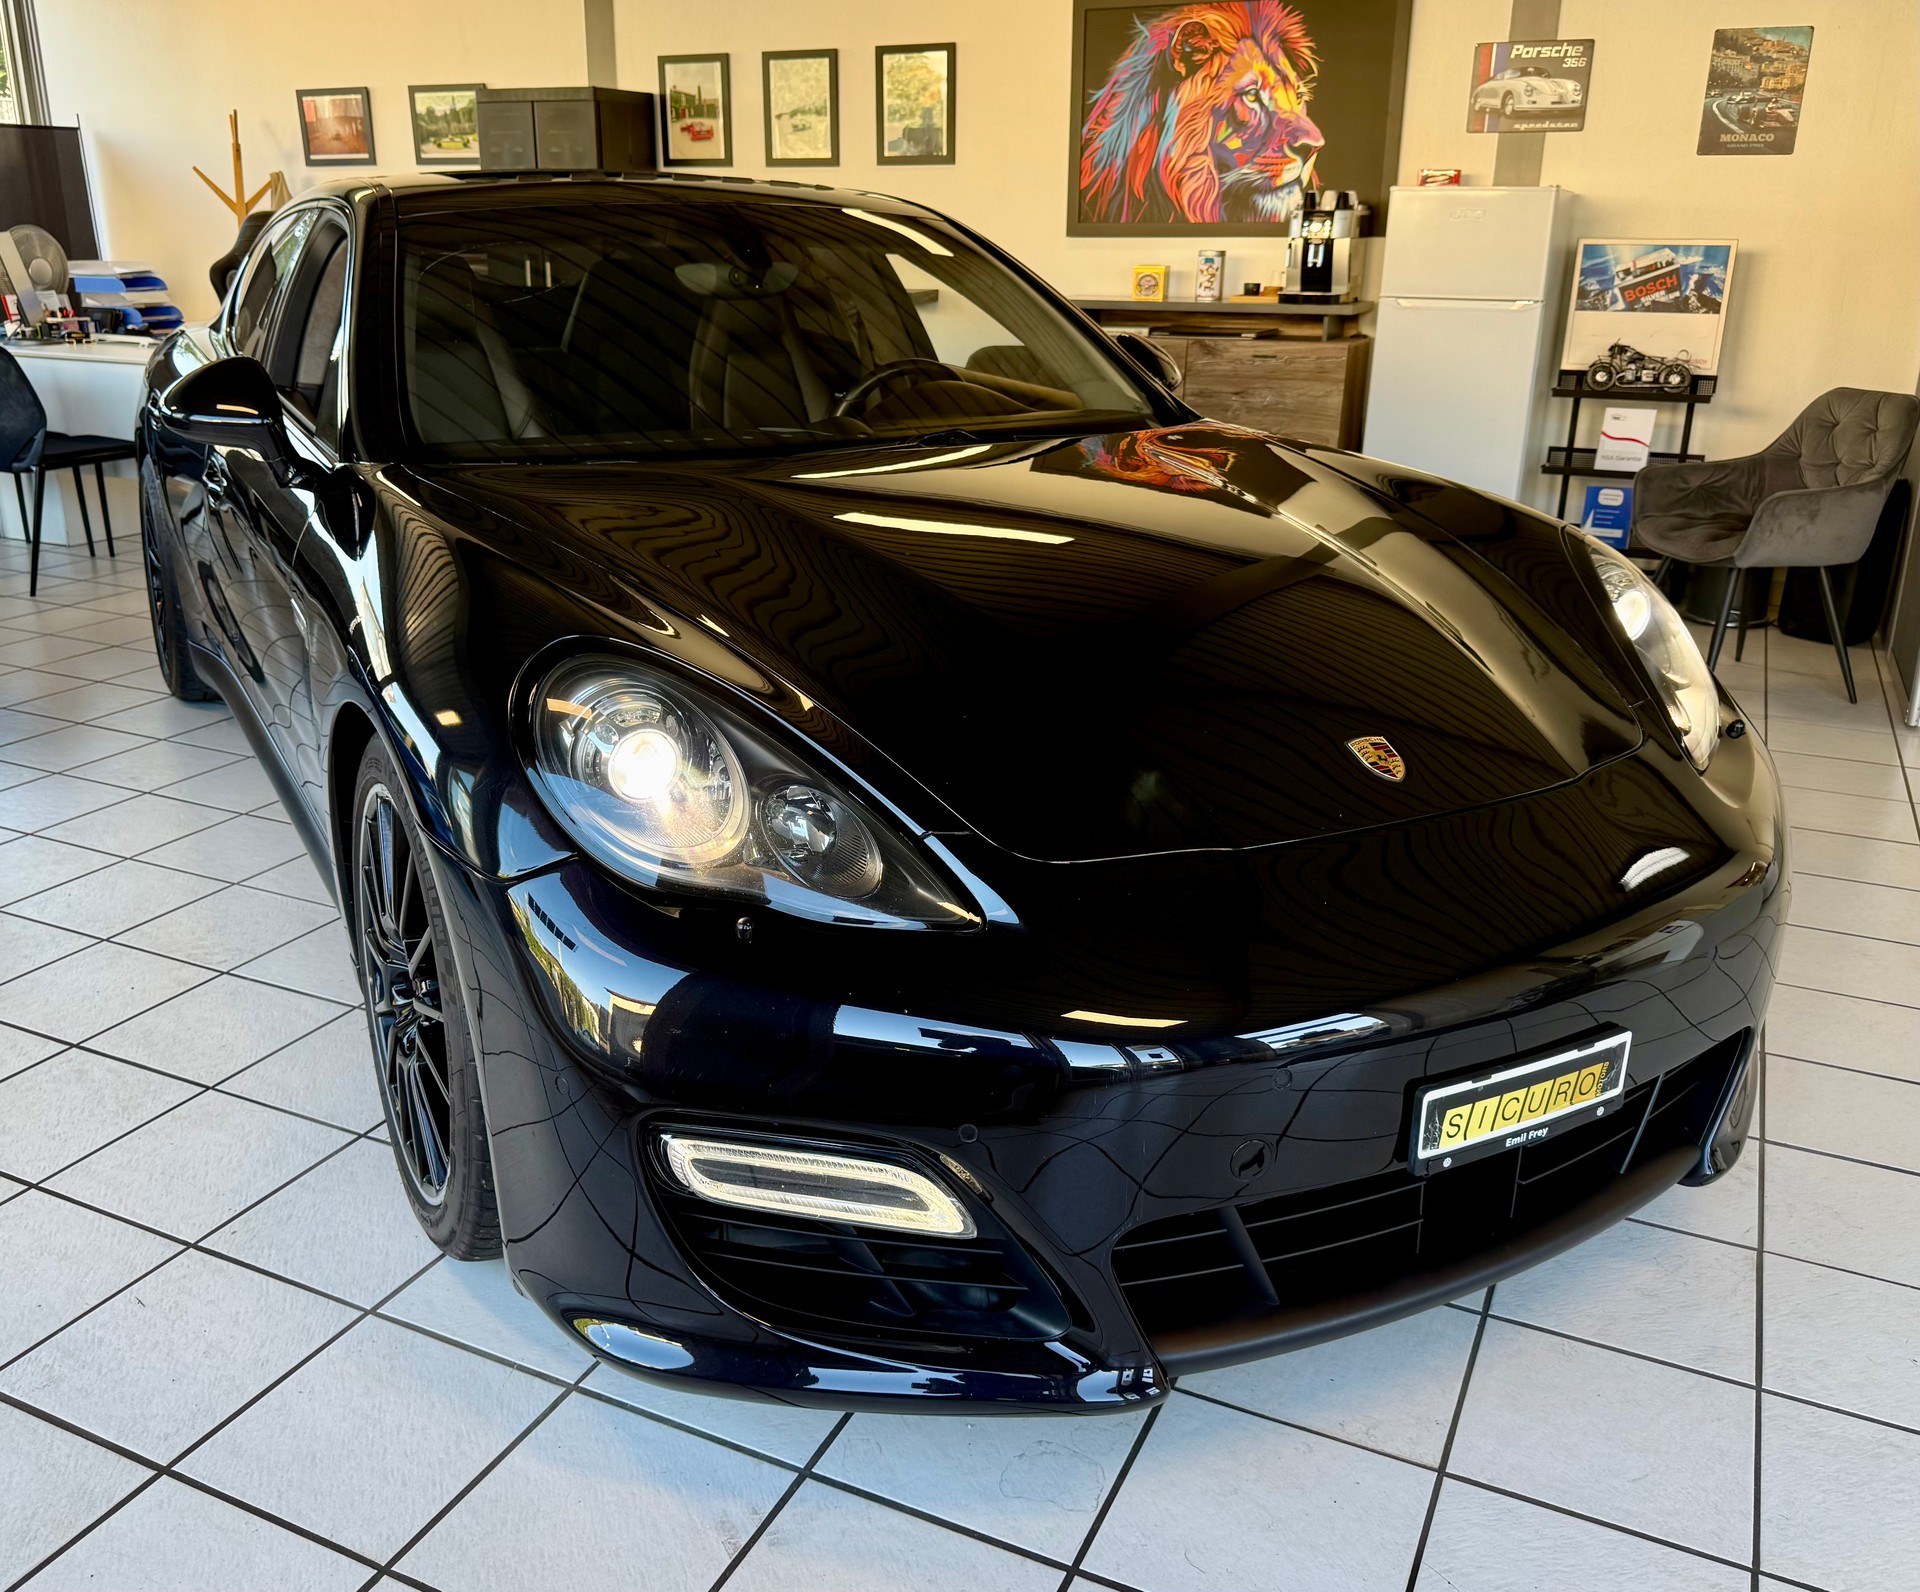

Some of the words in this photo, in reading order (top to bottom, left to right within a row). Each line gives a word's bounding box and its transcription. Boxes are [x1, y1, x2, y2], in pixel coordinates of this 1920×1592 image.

[1510, 42, 1584, 59] Porsche
[1562, 57, 1587, 68] 356
[1719, 133, 1775, 142] MONACO
[1624, 274, 1679, 303] BOSCH
[1446, 1072, 1597, 1139] SICURO
[1505, 1131, 1527, 1148] Emil
[1528, 1126, 1549, 1139] Frey
